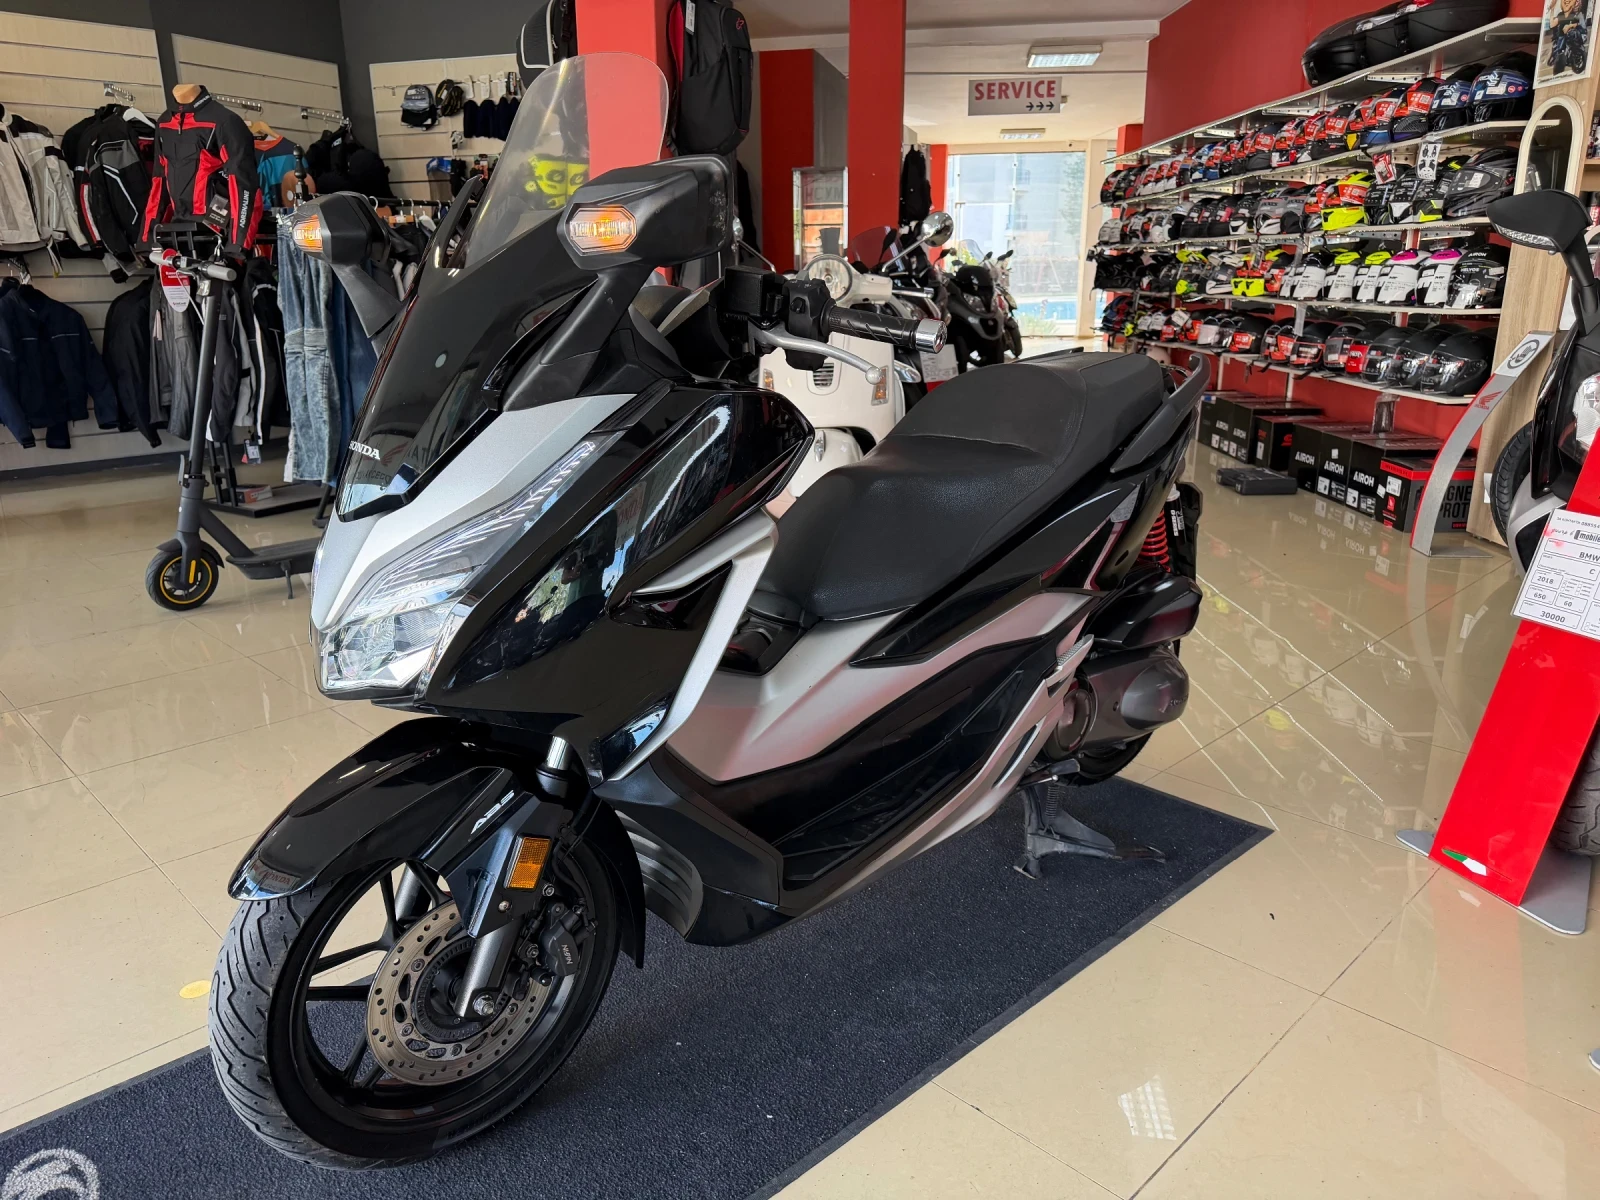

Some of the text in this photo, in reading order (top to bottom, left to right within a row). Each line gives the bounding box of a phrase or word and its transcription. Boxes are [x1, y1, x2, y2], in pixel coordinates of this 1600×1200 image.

[974, 80, 1056, 101] SERVICE
[240, 189, 250, 228] ADRENALINE
[1215, 420, 1229, 432] AIROH
[1233, 428, 1247, 440] AIROH
[1295, 451, 1315, 466] AIROH
[1324, 460, 1345, 476] AIROH
[1353, 470, 1375, 487] AIROH
[1579, 551, 1600, 562] BMW
[1537, 575, 1554, 585] 2018
[1533, 592, 1547, 600] 650
[1563, 600, 1573, 608] 60
[1540, 610, 1566, 623] 30000
